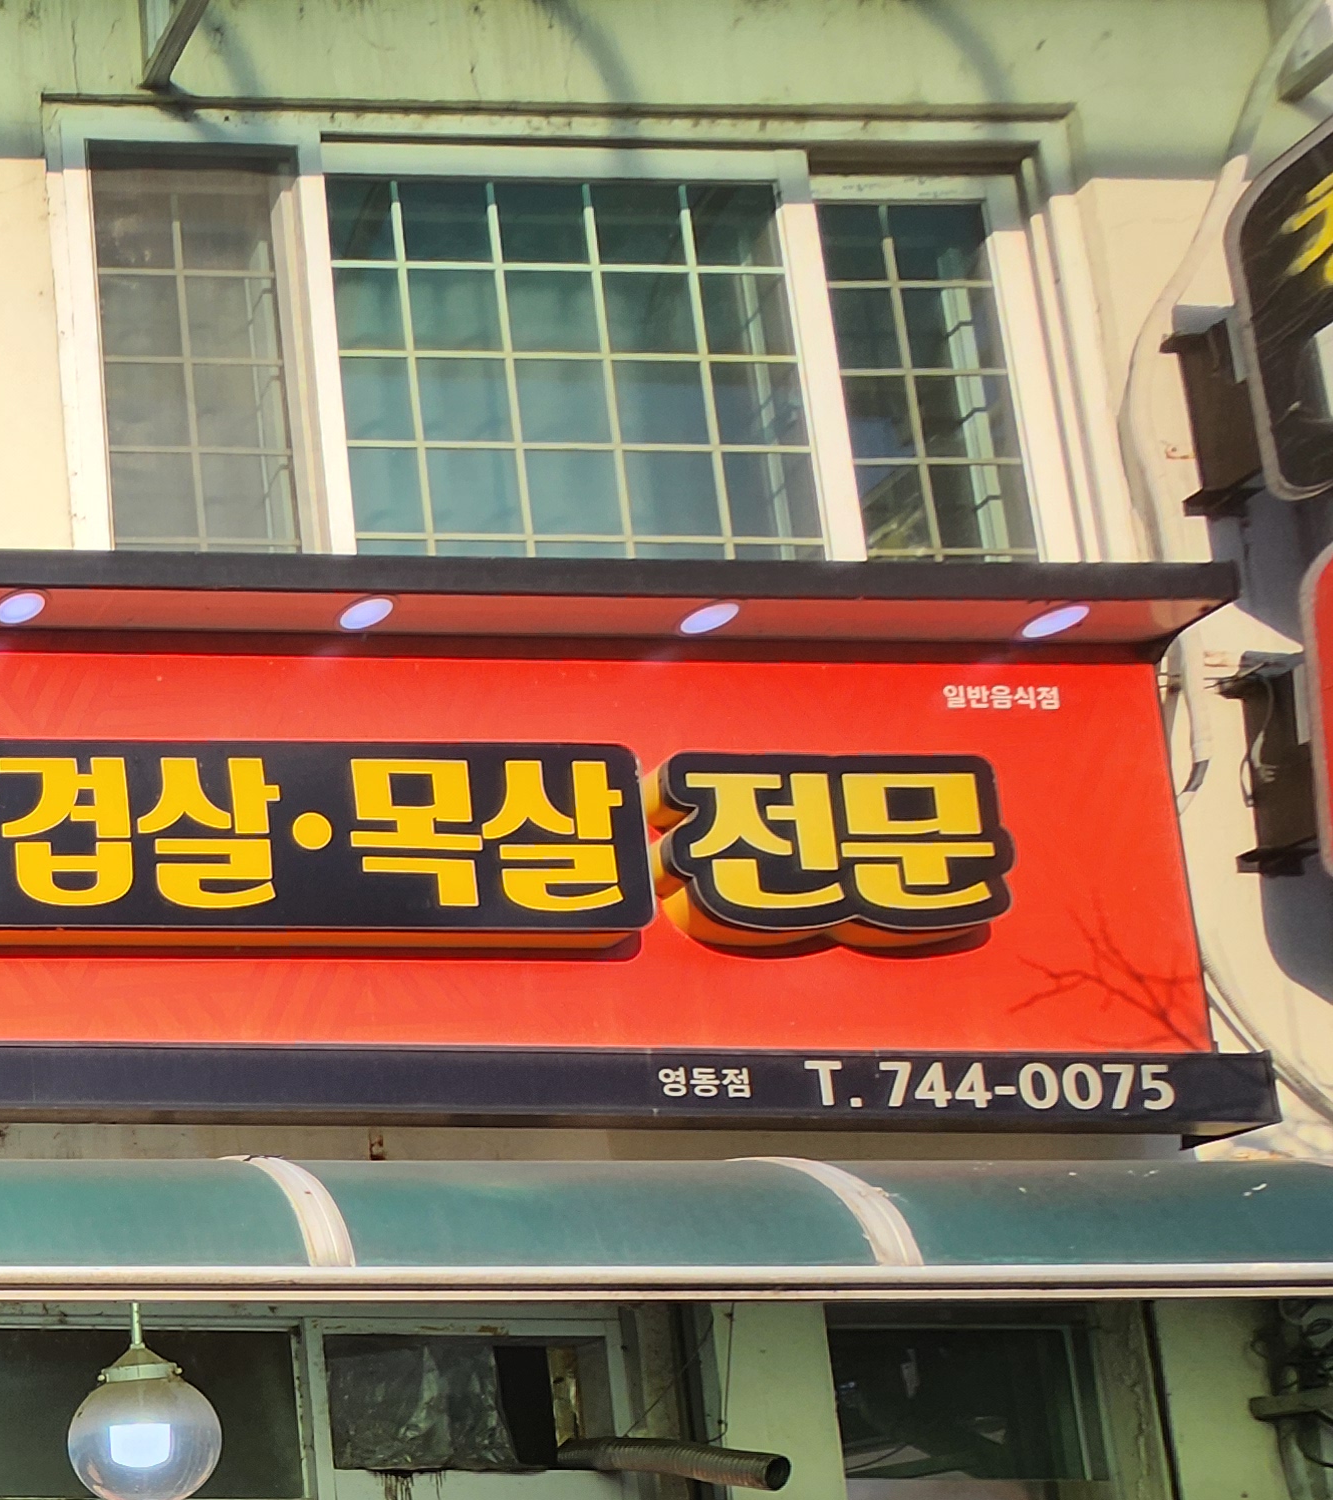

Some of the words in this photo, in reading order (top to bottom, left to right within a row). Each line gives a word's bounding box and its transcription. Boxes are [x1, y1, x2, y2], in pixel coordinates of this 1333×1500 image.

[942, 685, 1061, 710] 일반음식점
[680, 768, 999, 912] 전문
[657, 1066, 753, 1099] 영동점
[803, 1059, 863, 1109] T.
[878, 1060, 1176, 1111] 744-0075
